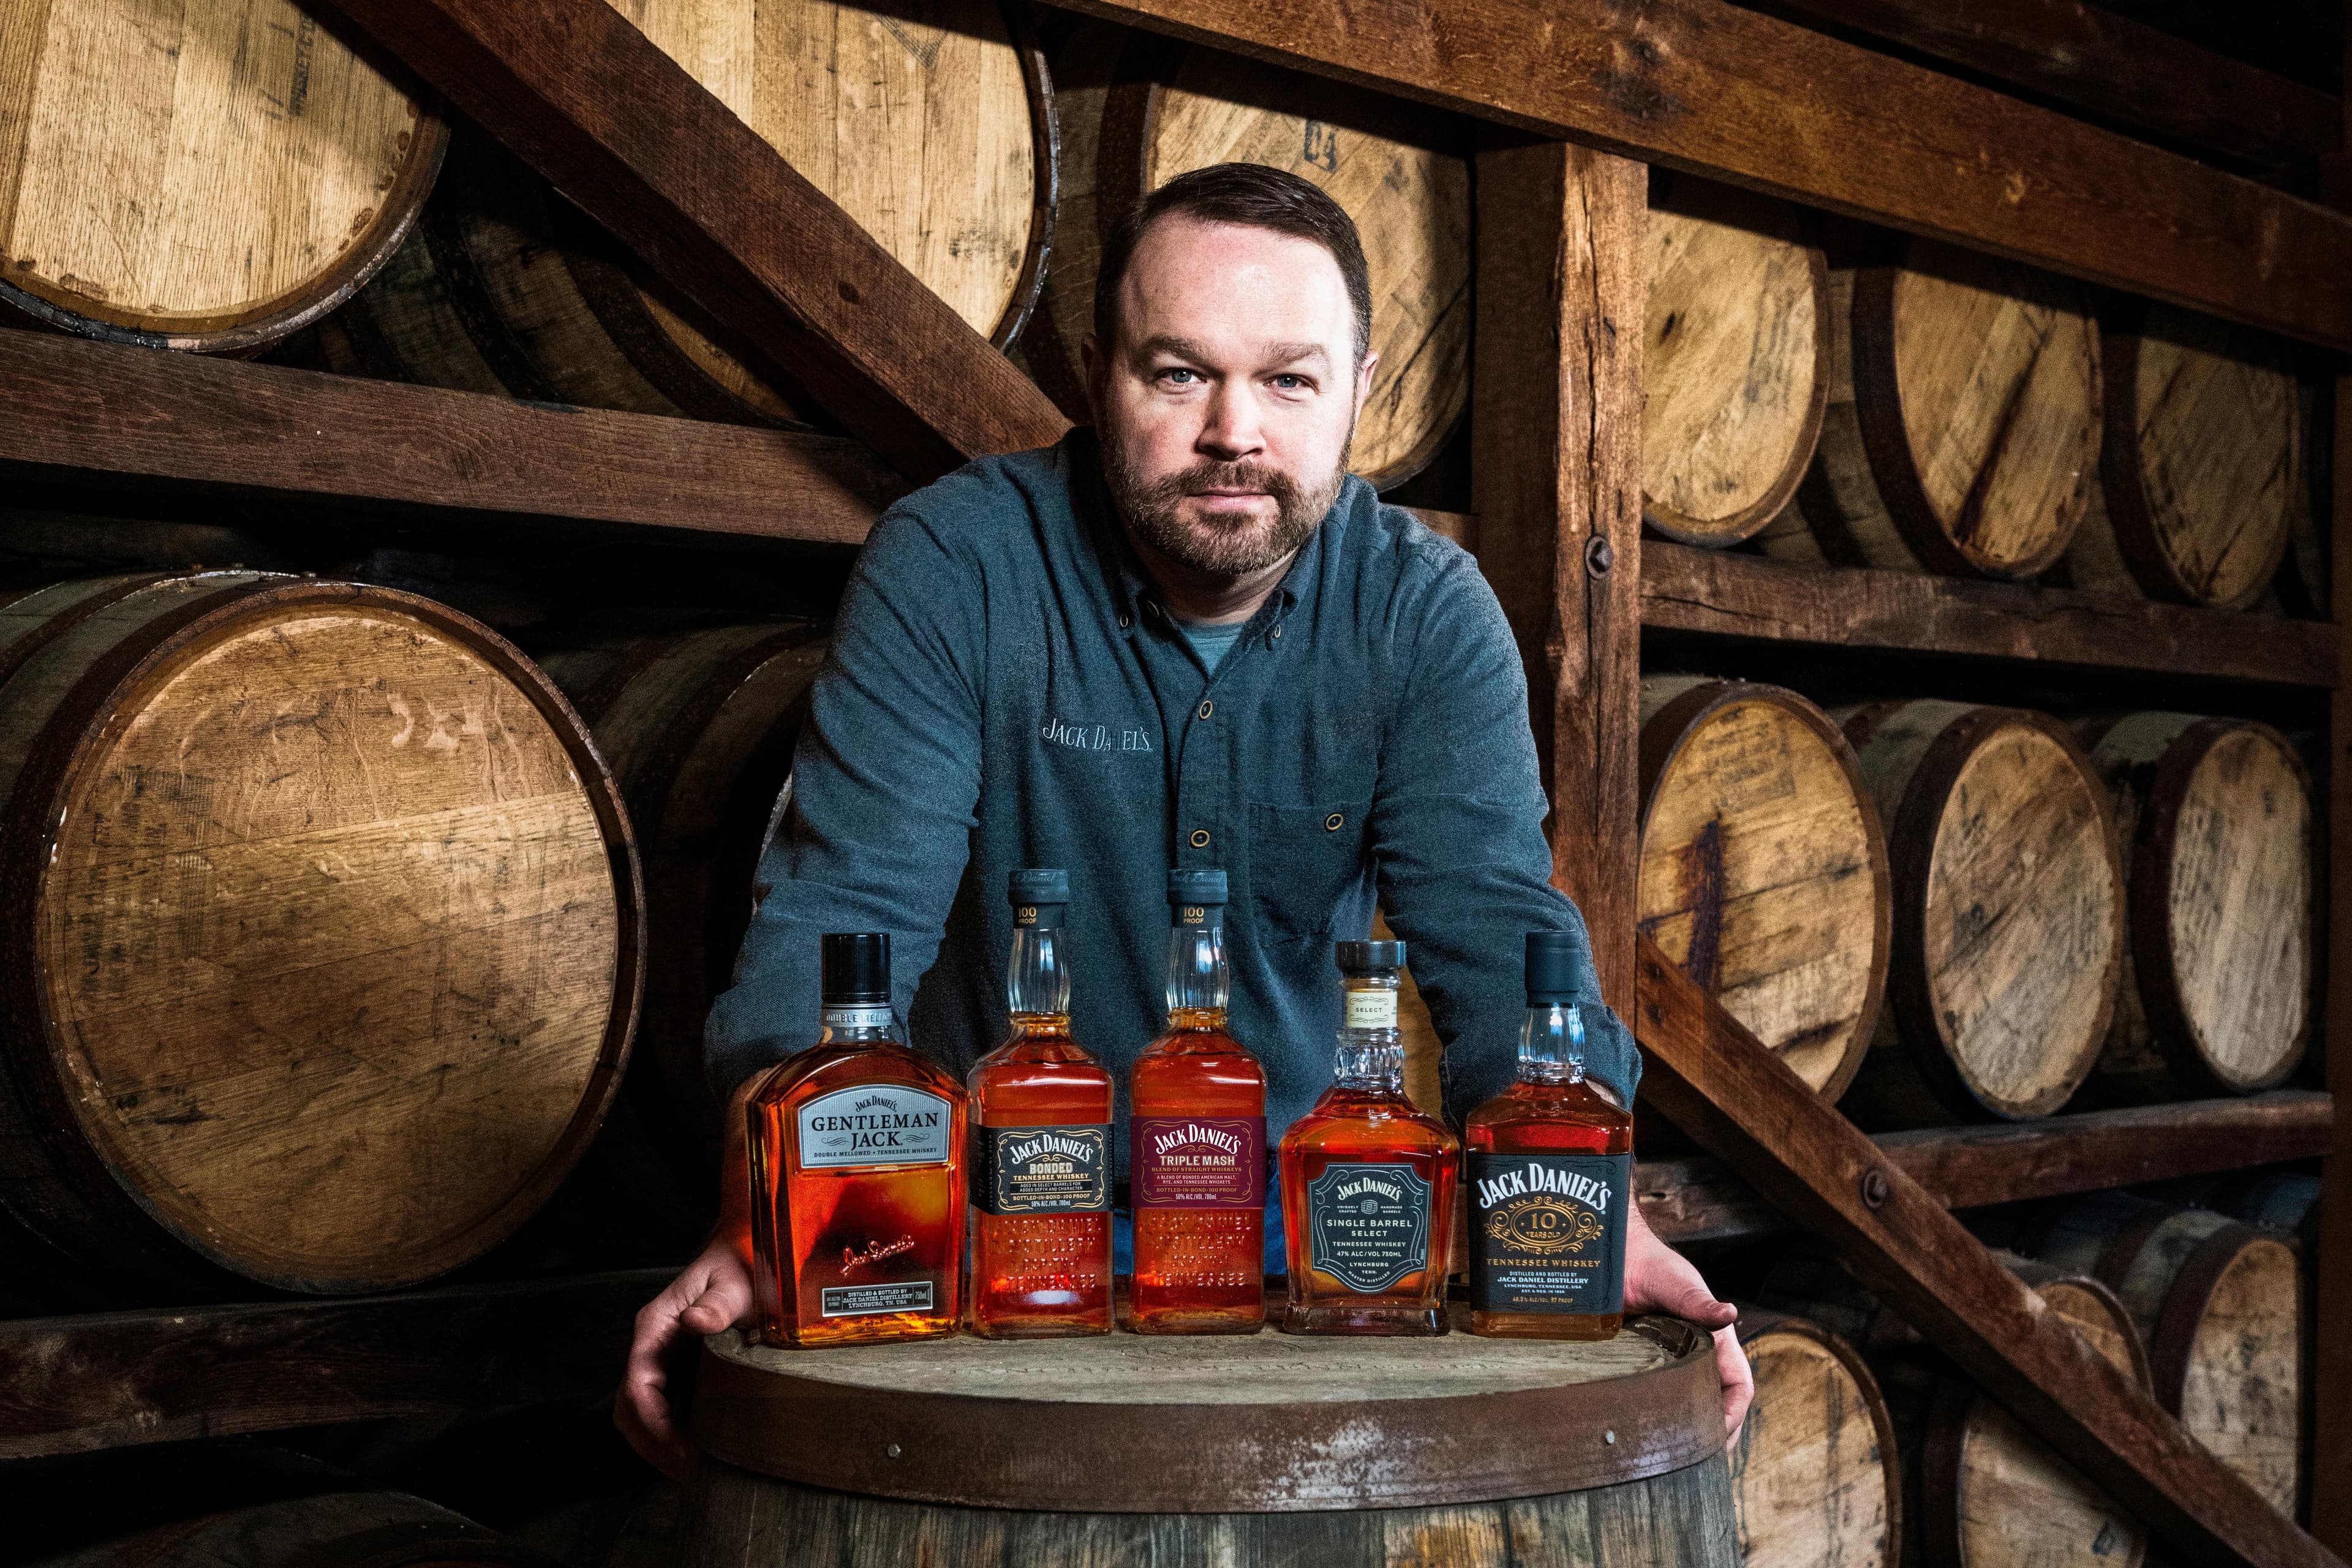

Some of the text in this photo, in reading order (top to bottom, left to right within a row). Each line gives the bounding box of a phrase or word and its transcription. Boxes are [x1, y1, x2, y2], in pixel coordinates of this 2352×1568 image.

[1042, 718, 1150, 751] JACK DAEL'S
[1019, 907, 1036, 918] 100
[1185, 907, 1204, 917] 100
[855, 1095, 897, 1112] JACK DANIEL'S
[811, 1112, 939, 1131] GENTLEMAN
[851, 1131, 902, 1150] JACK
[1154, 1124, 1242, 1154] JACK DANIEL'S
[1010, 1134, 1093, 1164] JACK DANIEL'S
[1029, 1163, 1072, 1174] BONDED
[1160, 1155, 1235, 1166] TRIPLE MASH
[1337, 1177, 1403, 1200] JACK DANIEL'S
[1477, 1164, 1612, 1210] JACK DANIEL'S
[1531, 1213, 1557, 1229] 10
[1348, 1271, 1390, 1283] MASTER DISTILLED
